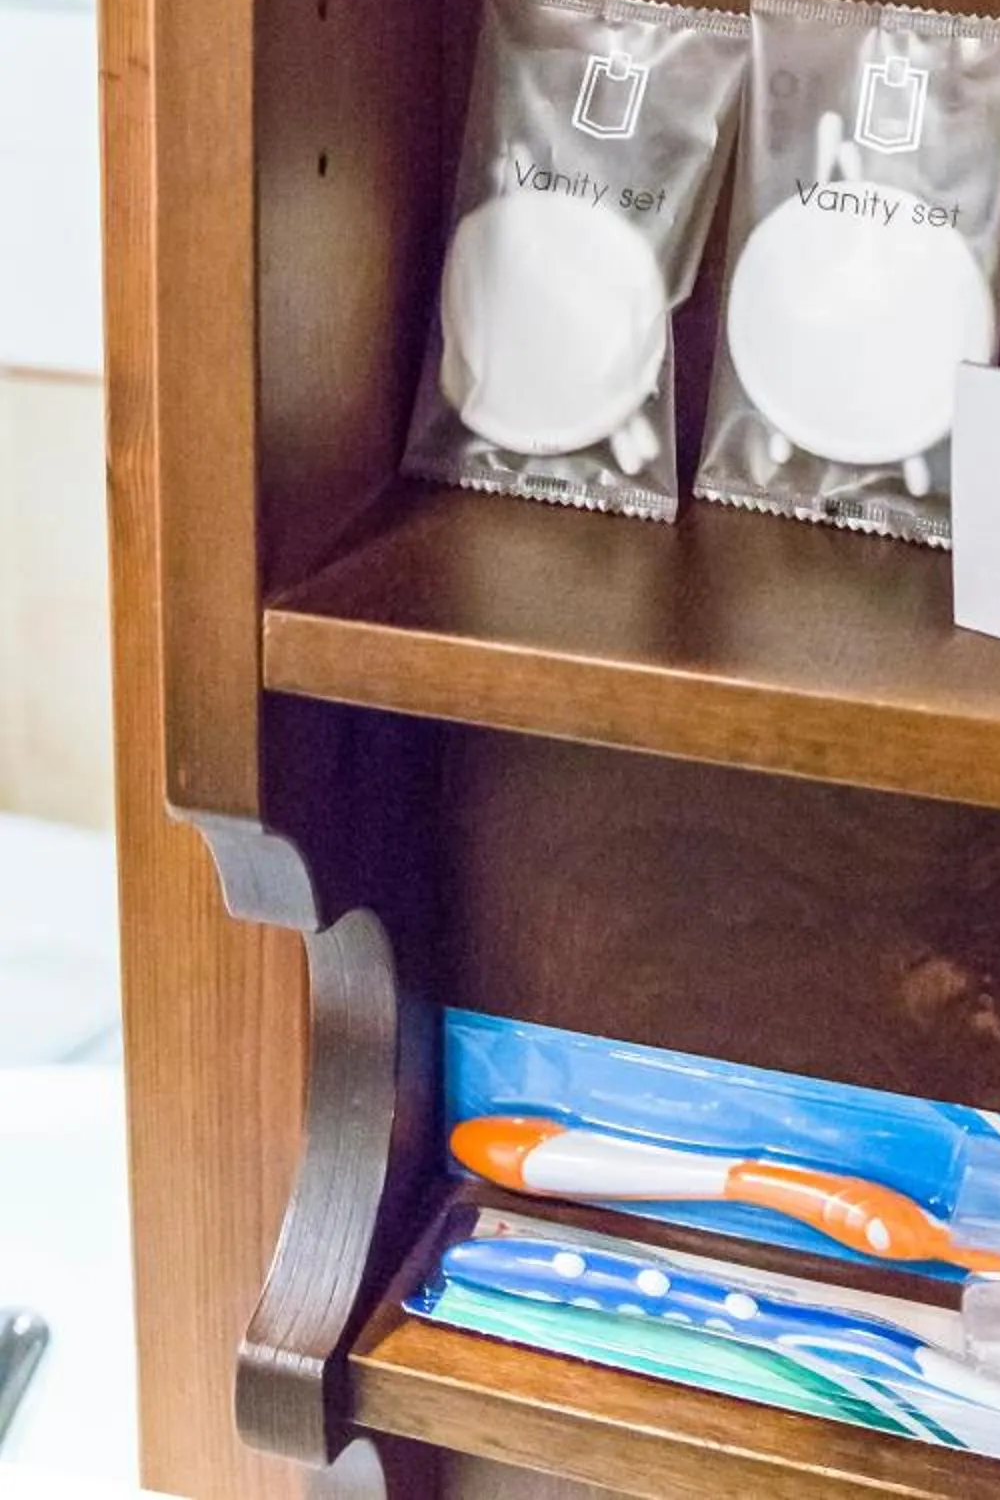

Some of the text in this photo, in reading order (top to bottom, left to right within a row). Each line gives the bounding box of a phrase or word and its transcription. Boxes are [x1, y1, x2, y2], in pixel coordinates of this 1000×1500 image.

[515, 160, 667, 214] Vanity set
[795, 178, 962, 228] Vanity set
